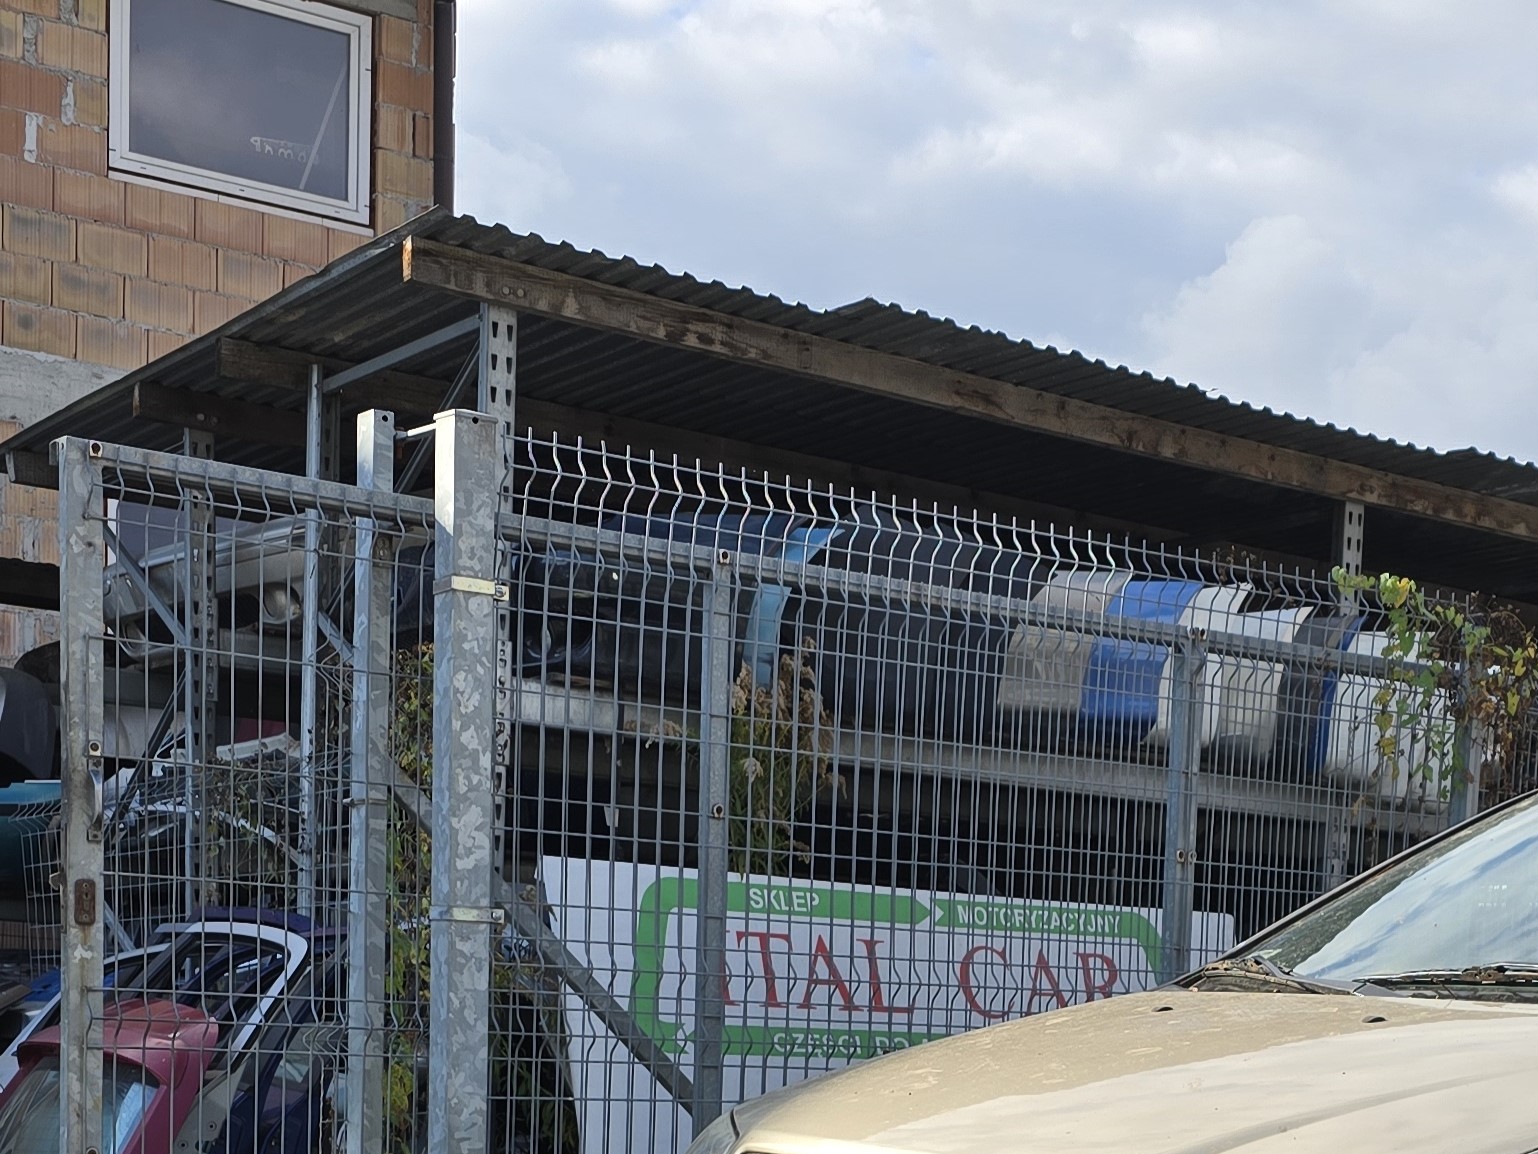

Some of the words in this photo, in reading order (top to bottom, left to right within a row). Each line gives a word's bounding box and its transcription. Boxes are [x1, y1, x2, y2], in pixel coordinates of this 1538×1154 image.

[749, 888, 820, 913] SKLEP
[957, 904, 1121, 934] MOTORYZACYJNY
[959, 945, 1118, 1020] CAR
